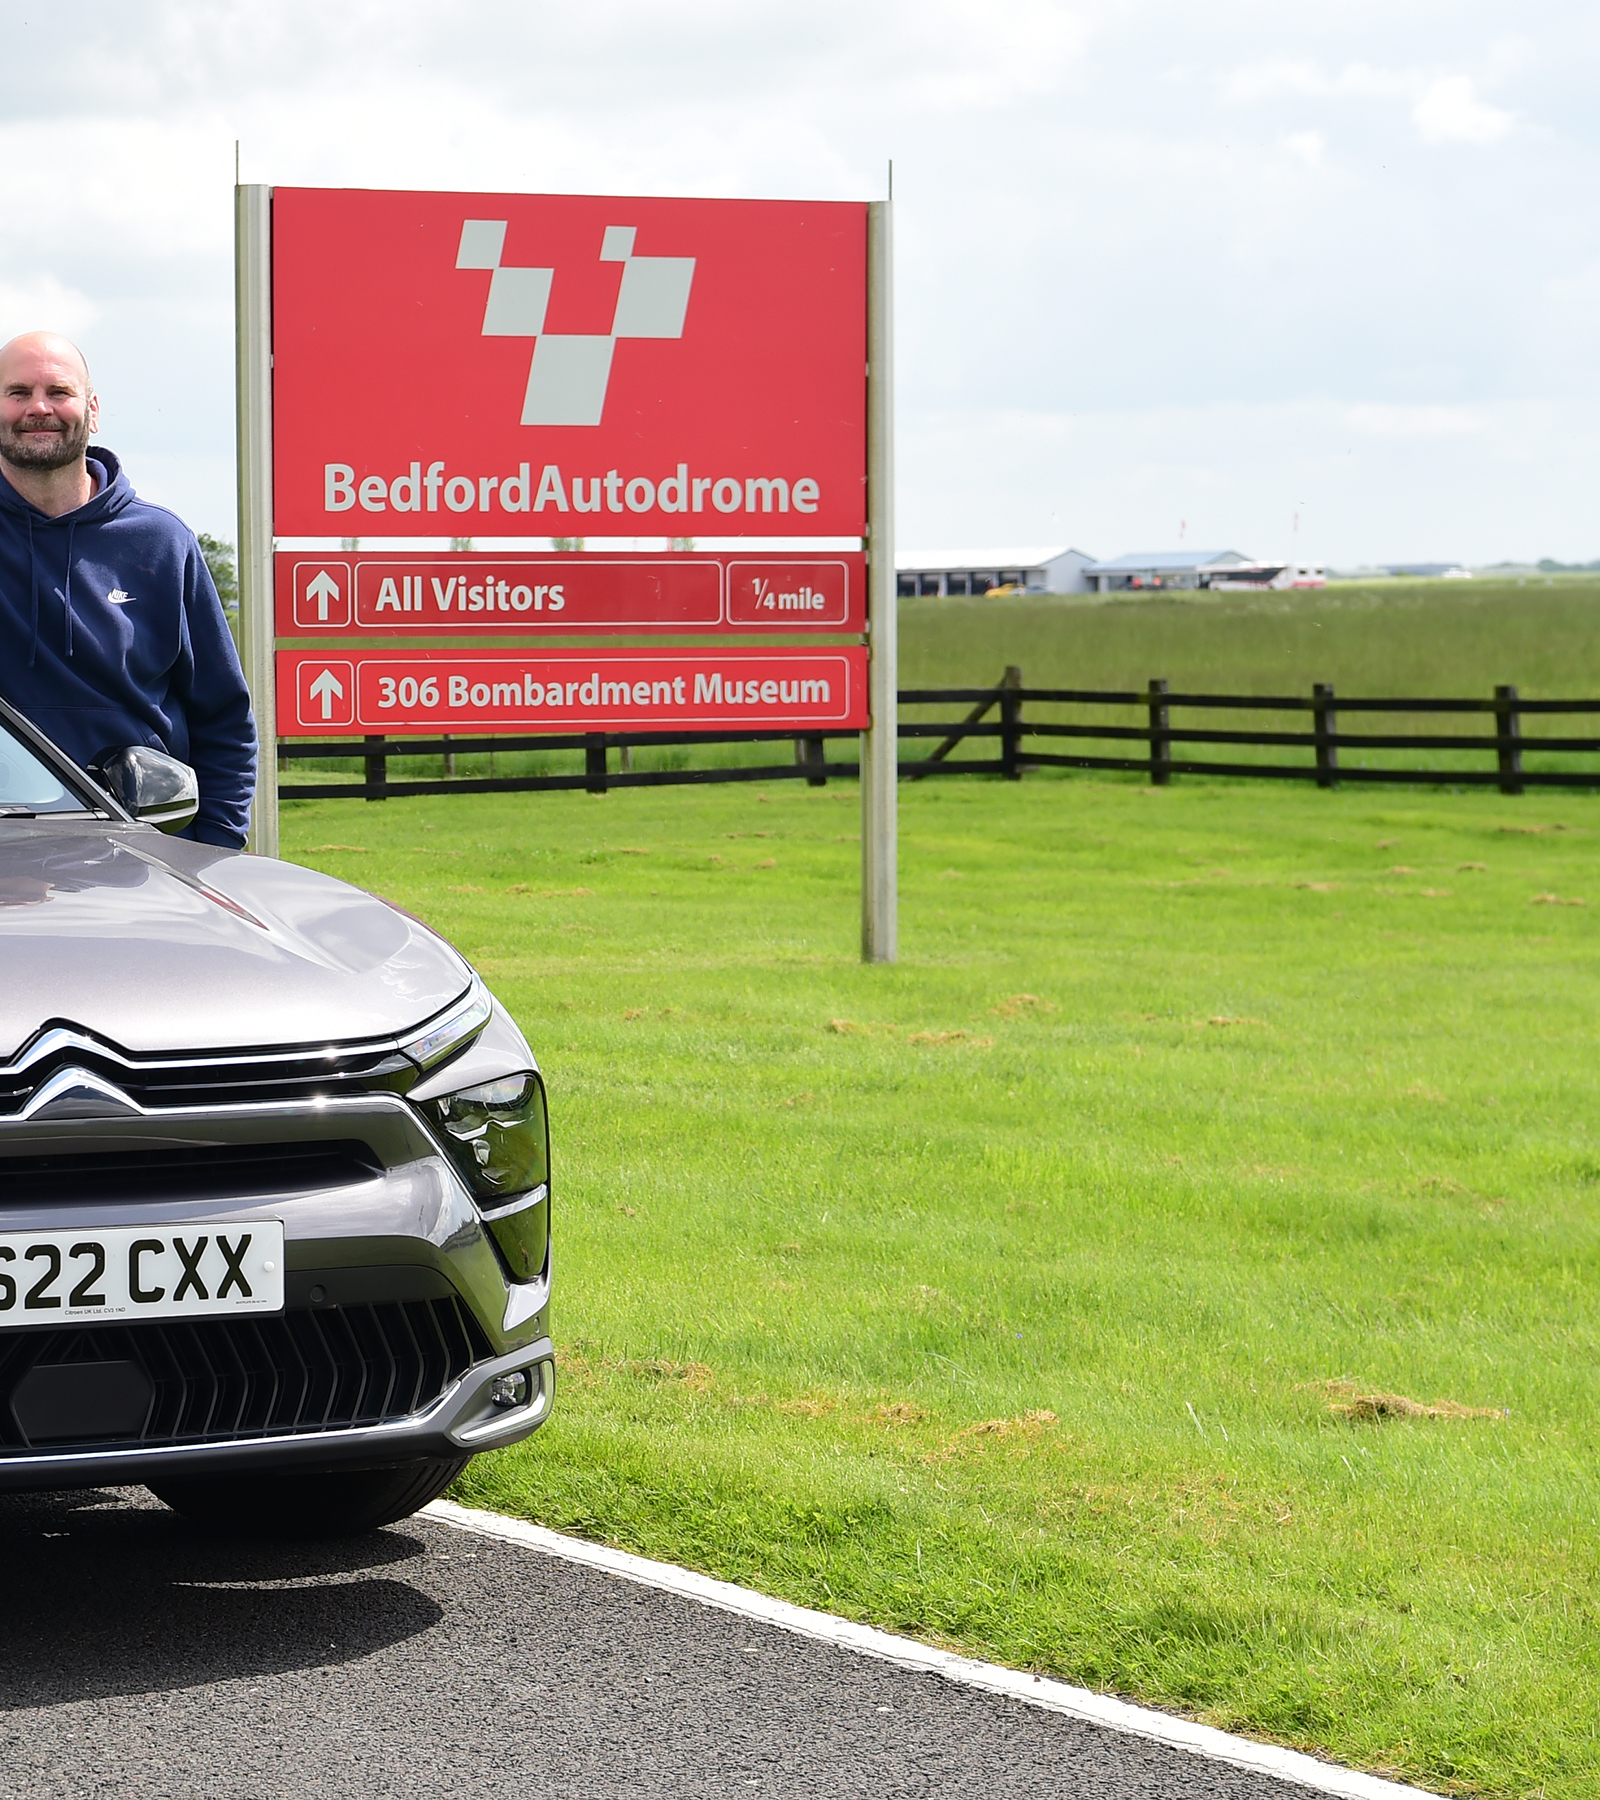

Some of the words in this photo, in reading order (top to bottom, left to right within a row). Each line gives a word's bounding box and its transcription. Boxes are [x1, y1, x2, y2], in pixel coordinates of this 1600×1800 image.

[323, 461, 821, 514] BedfordAutodrome
[374, 575, 424, 612] All
[429, 575, 566, 612] Visitors
[778, 587, 826, 610] mile
[376, 676, 441, 709] 306
[447, 672, 687, 708] Bombardment
[692, 672, 831, 705] Museum
[128, 1233, 254, 1304] CXX
